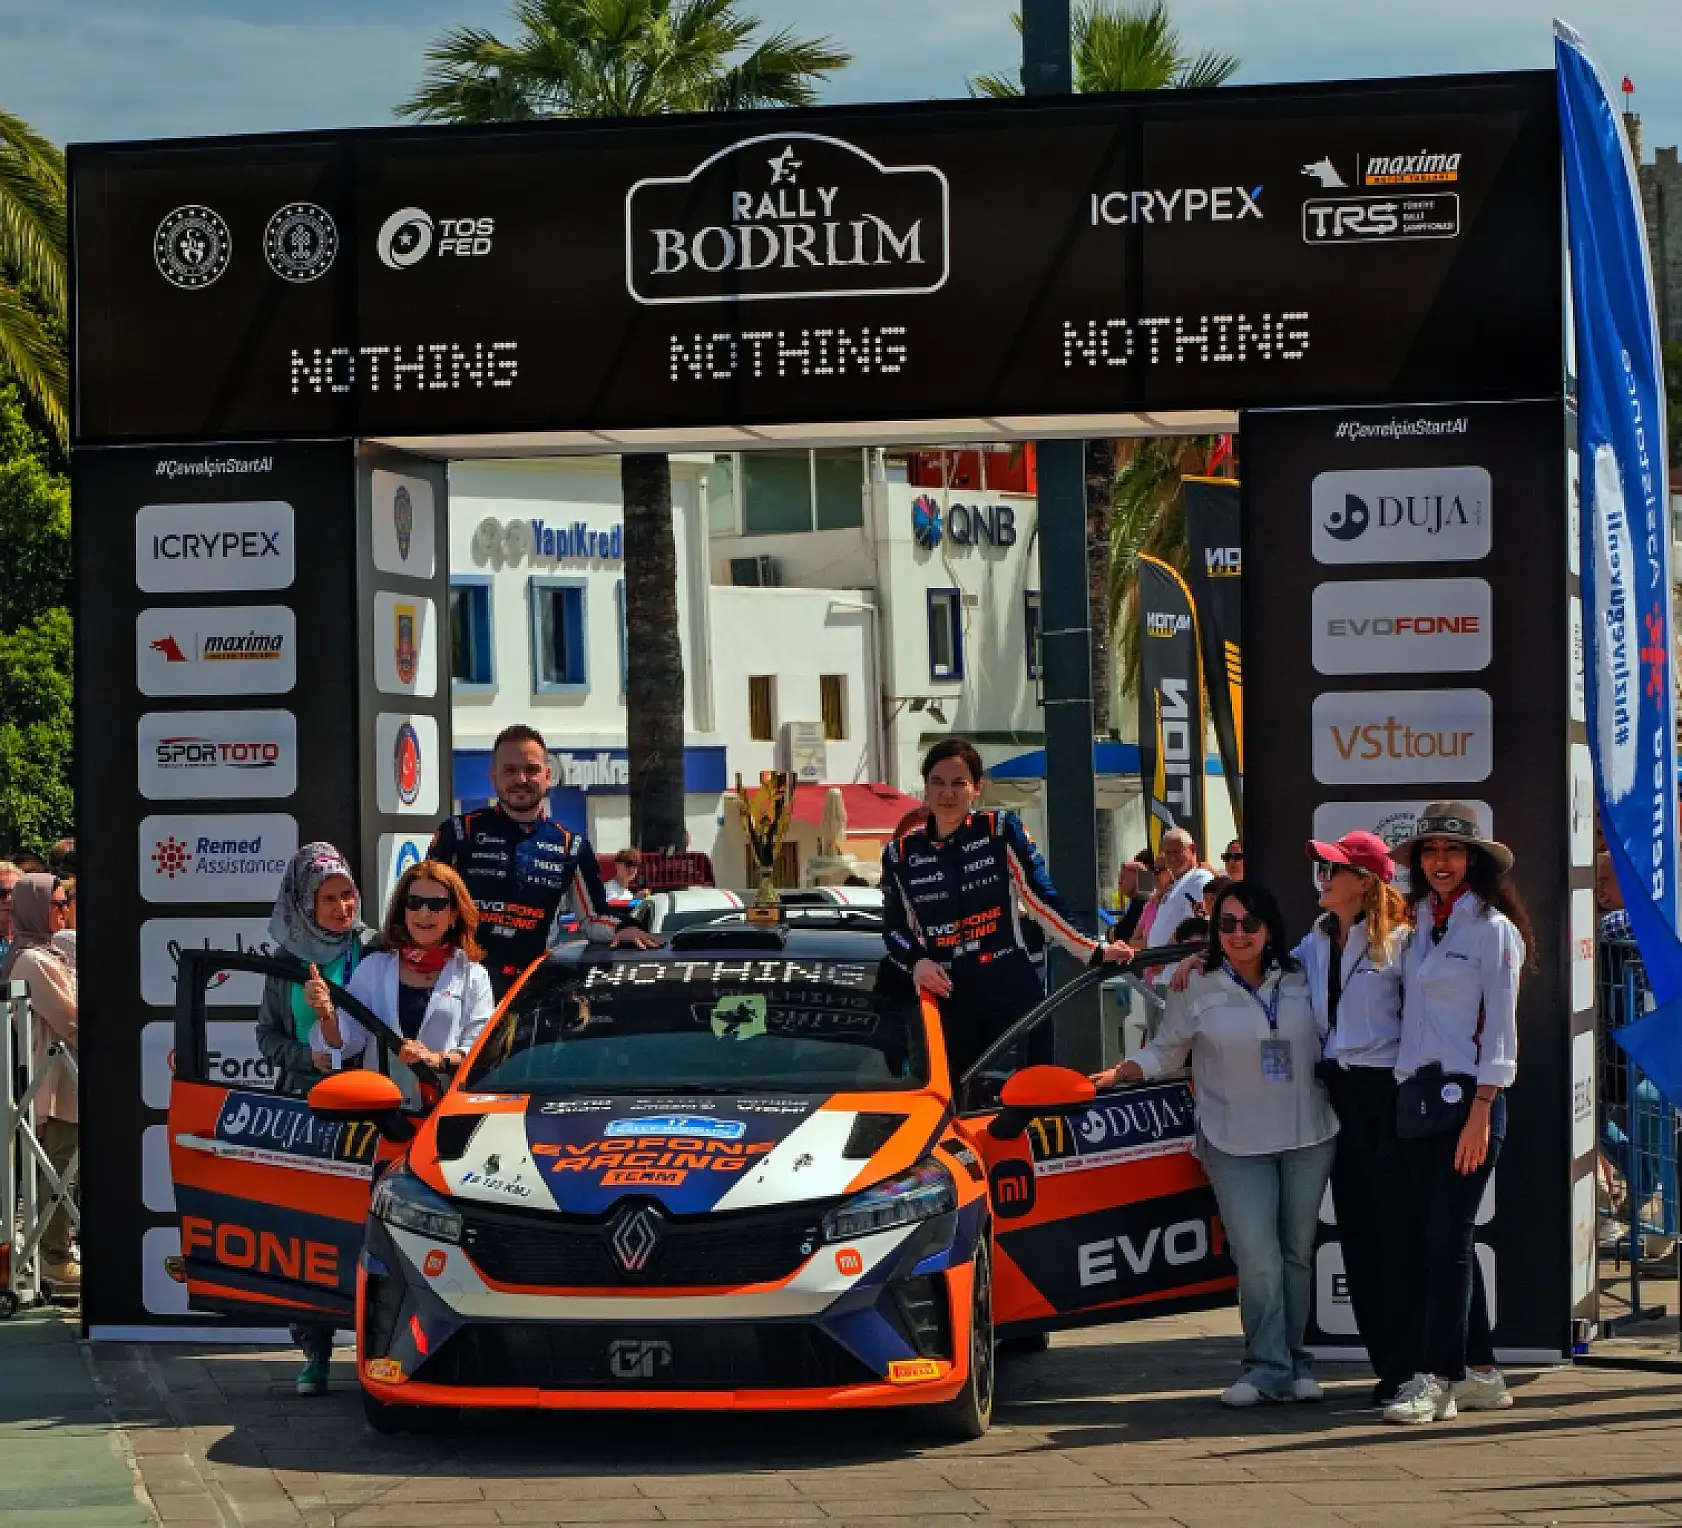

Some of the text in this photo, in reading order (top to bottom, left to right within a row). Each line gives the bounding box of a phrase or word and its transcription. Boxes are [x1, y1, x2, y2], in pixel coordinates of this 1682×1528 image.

[1368, 149, 1462, 174] maxima
[733, 187, 839, 221] RALLY
[1092, 185, 1264, 226] ICRYPEX
[1308, 203, 1398, 236] TRS
[439, 217, 494, 236] TOS
[438, 236, 494, 257] FED
[650, 216, 925, 275] BODRUM
[670, 327, 907, 382] NOTHING
[1063, 312, 1310, 369] NOTHING
[292, 342, 518, 393] NOTHING
[948, 503, 1016, 547] QNB
[1377, 495, 1468, 533] DUJA
[153, 531, 280, 559] ICRYPEX
[531, 518, 622, 562] YapıKred
[204, 630, 283, 651] maxima
[1327, 616, 1479, 636] EVOFONE
[196, 836, 262, 853] Remed
[195, 856, 286, 873] Assistance
[584, 961, 866, 988] NOTHING
[250, 1106, 314, 1148] DUJA
[1104, 1098, 1183, 1138] DUJA
[343, 1121, 377, 1158] 17
[531, 1138, 776, 1156] EVOFONE
[1029, 1116, 1064, 1156] 17
[552, 1156, 749, 1172] RACING
[612, 1172, 678, 1182] TEAM
